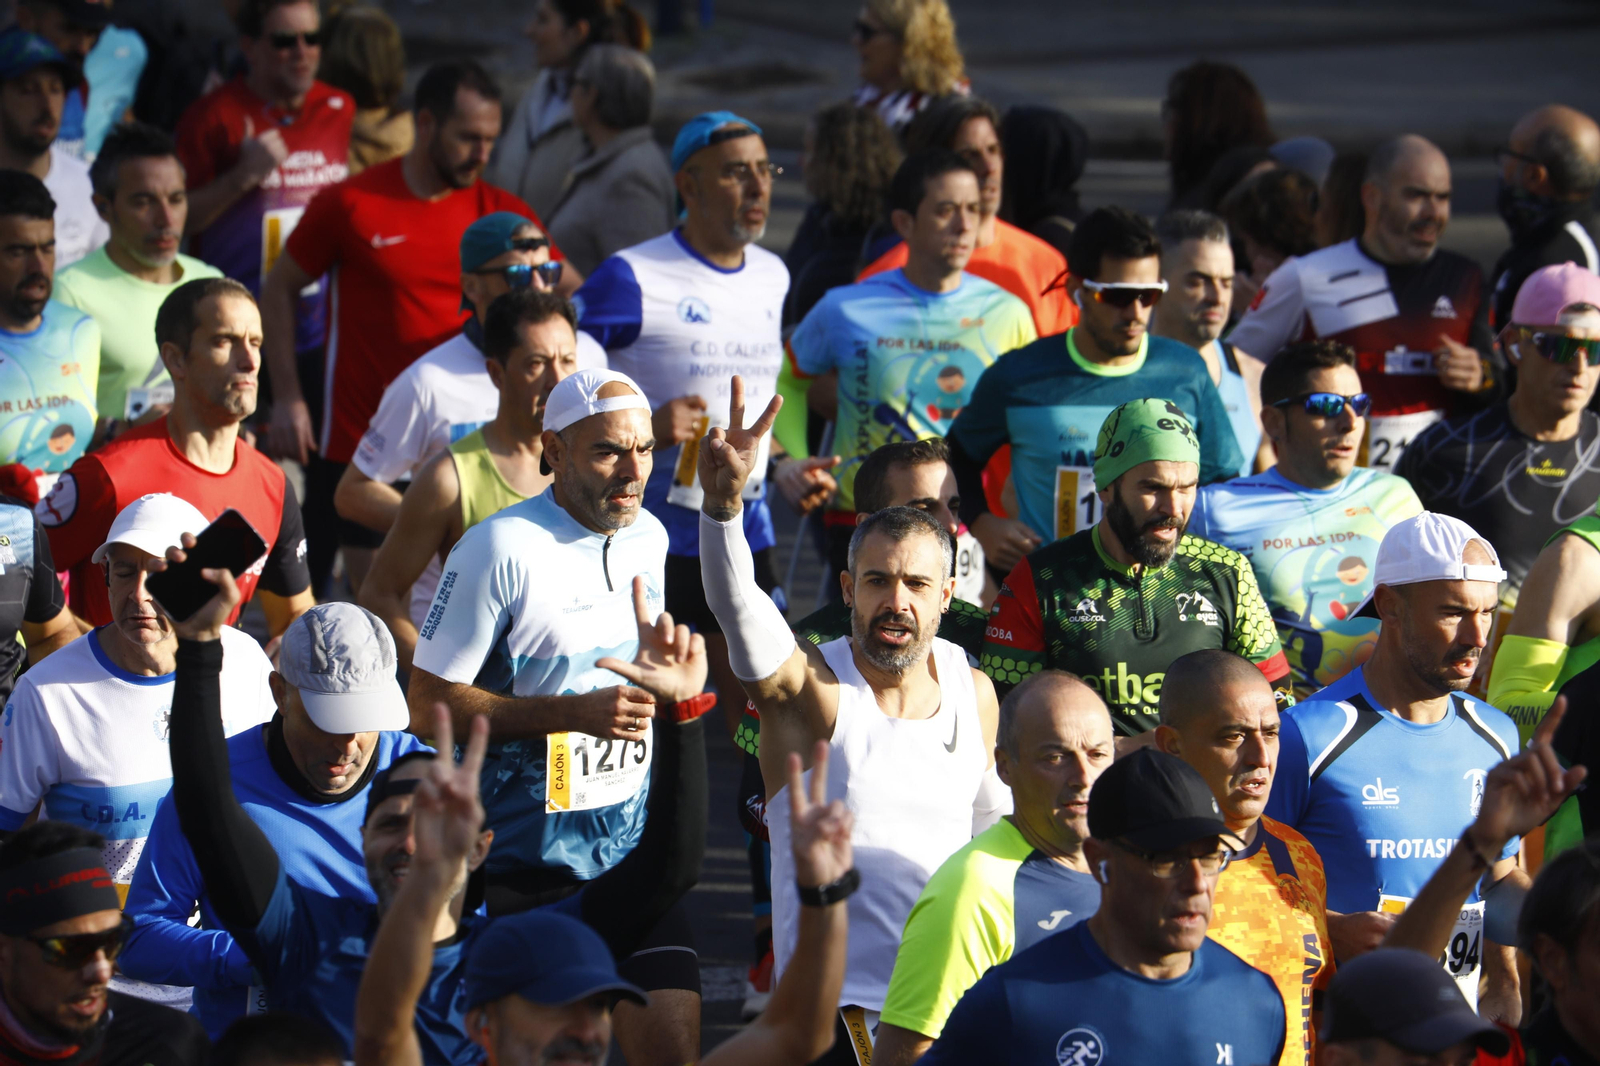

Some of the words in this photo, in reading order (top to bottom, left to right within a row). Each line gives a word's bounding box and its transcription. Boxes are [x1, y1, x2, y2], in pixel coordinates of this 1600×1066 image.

[877, 336, 905, 350] POR
[909, 338, 935, 350] LAS
[716, 383, 760, 398] SELA
[0, 401, 13, 412] R
[17, 397, 42, 411] LAS
[1263, 538, 1294, 550] POR
[1299, 536, 1325, 547] LAS
[420, 604, 439, 637] ULTRA
[437, 570, 454, 601] TRAIL
[426, 605, 446, 641] BOSQUES
[442, 590, 451, 605] DEL
[448, 571, 458, 589] SUR
[1081, 662, 1166, 705] etba
[1143, 705, 1159, 715] Qu
[574, 737, 647, 776] 1275
[554, 753, 564, 790] CAJÓN
[1362, 777, 1400, 805] als
[81, 802, 146, 824] C.D.A.
[1443, 930, 1481, 974] 94
[256, 989, 268, 1014] JÓN
